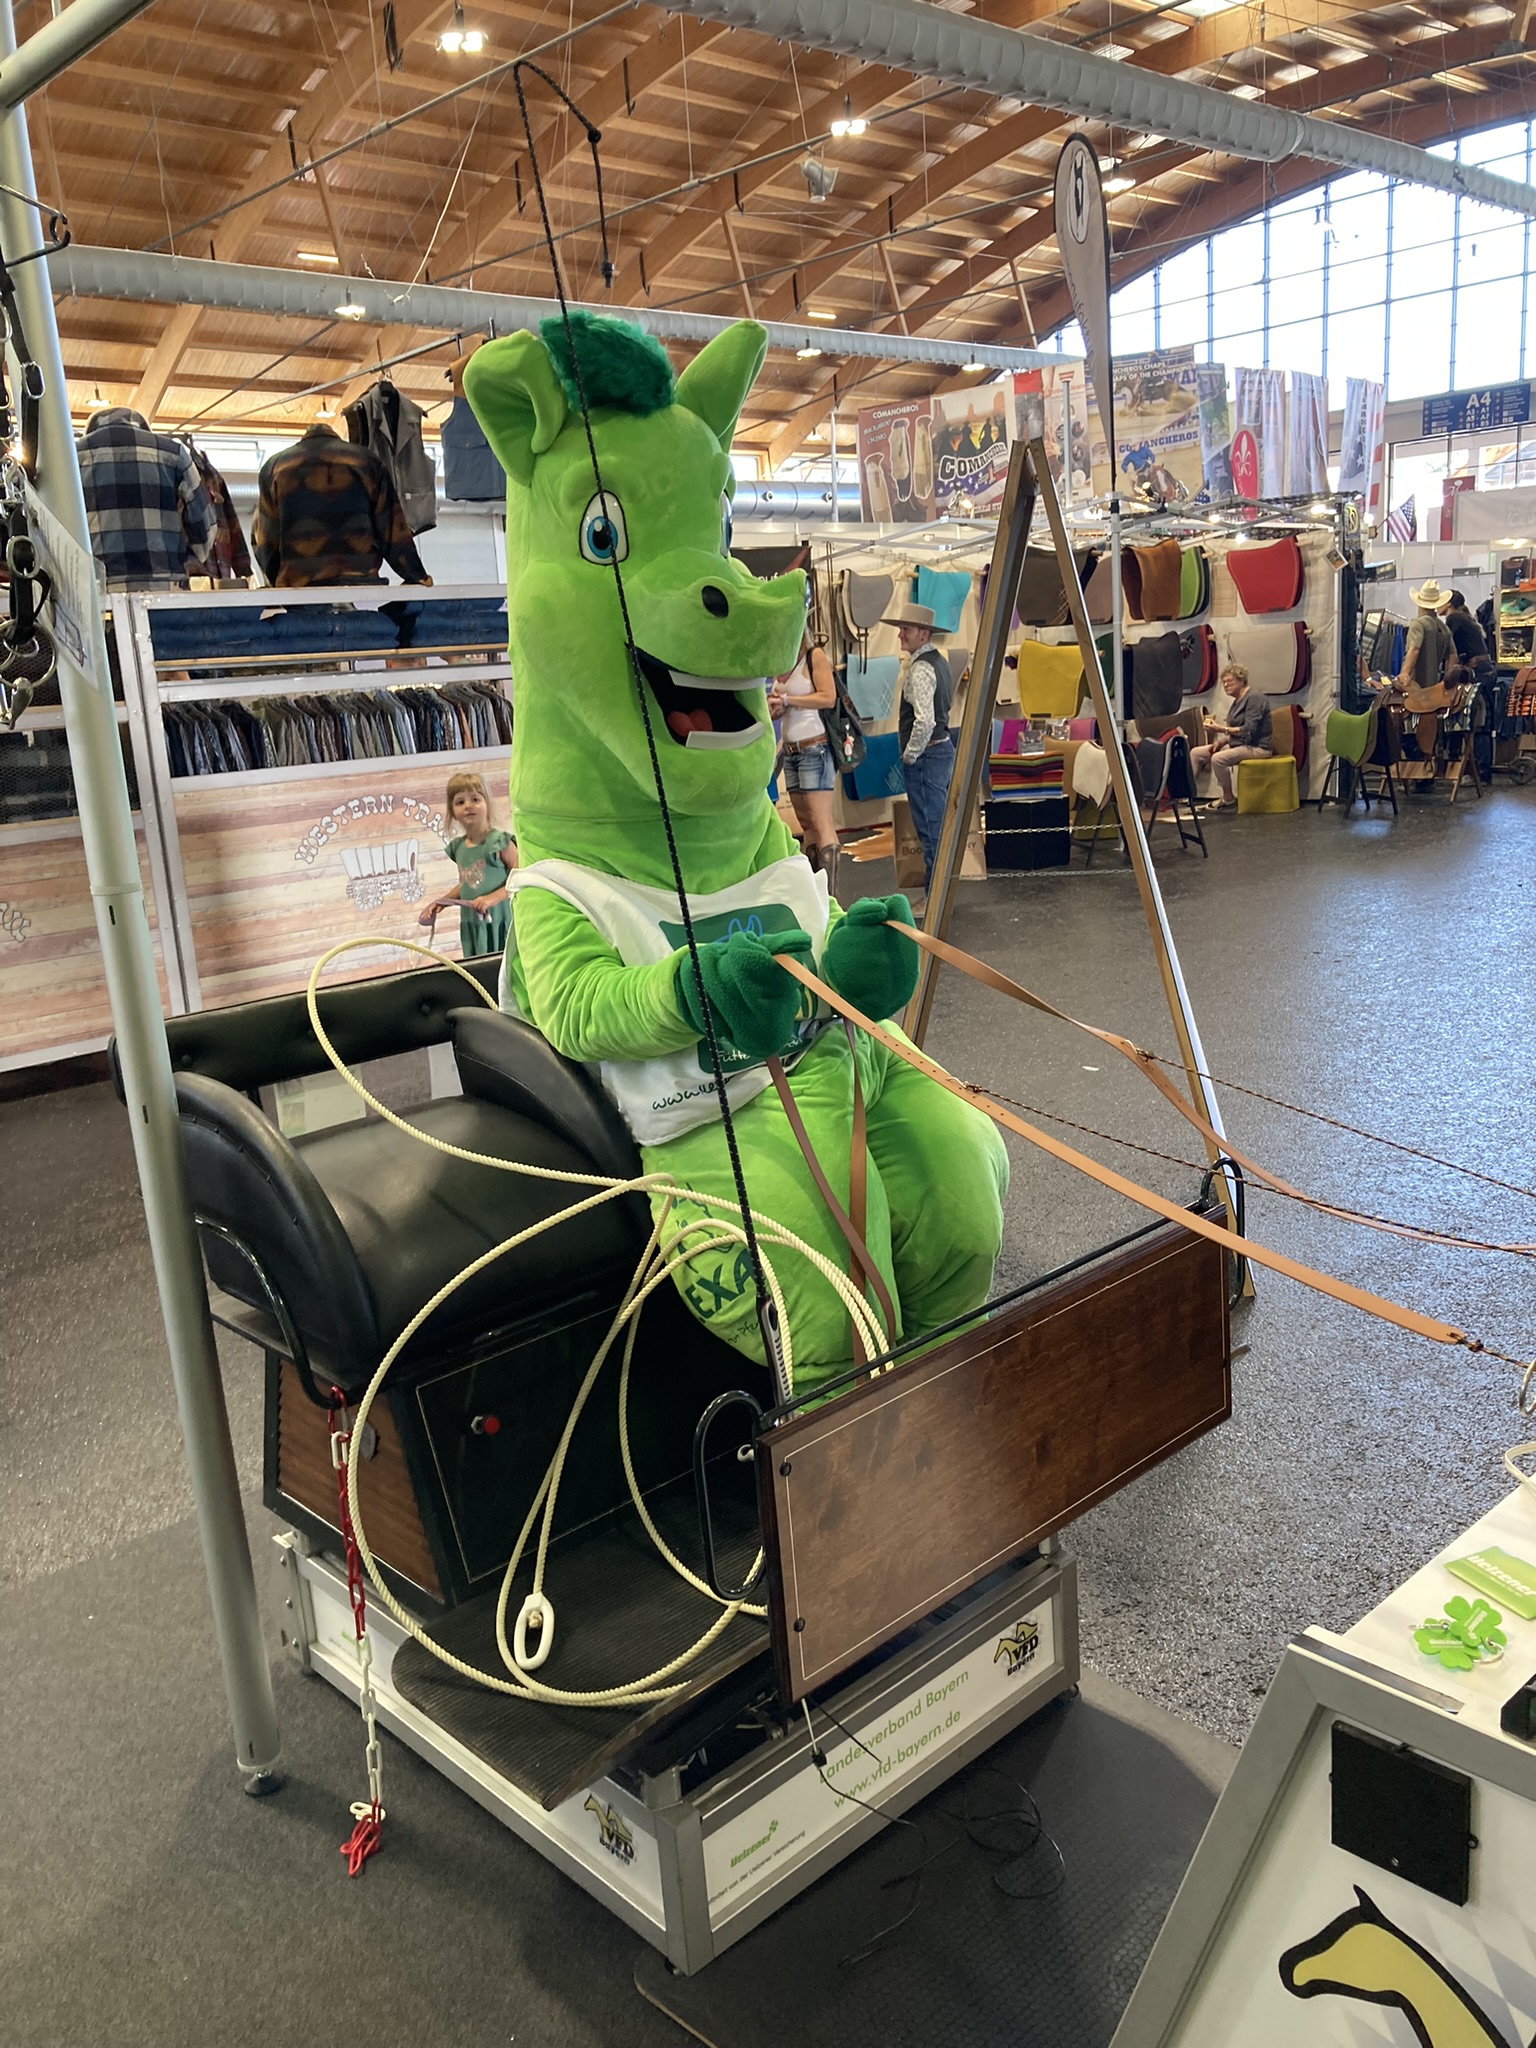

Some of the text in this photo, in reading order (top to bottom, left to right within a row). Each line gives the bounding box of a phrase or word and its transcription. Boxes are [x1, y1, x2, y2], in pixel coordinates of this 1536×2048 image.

[1466, 391, 1492, 410] A4
[1118, 430, 1199, 454] COANCHEROS
[295, 794, 395, 865] WESTERN
[717, 1049, 751, 1063] Fütte
[1011, 1634, 1039, 1662] VFD
[1007, 1651, 1035, 1677] Bayern
[819, 1670, 970, 1785] Landesverband Bayern
[832, 1710, 962, 1809] www.vfd-bayern.de
[730, 1832, 773, 1868] Uelzener
